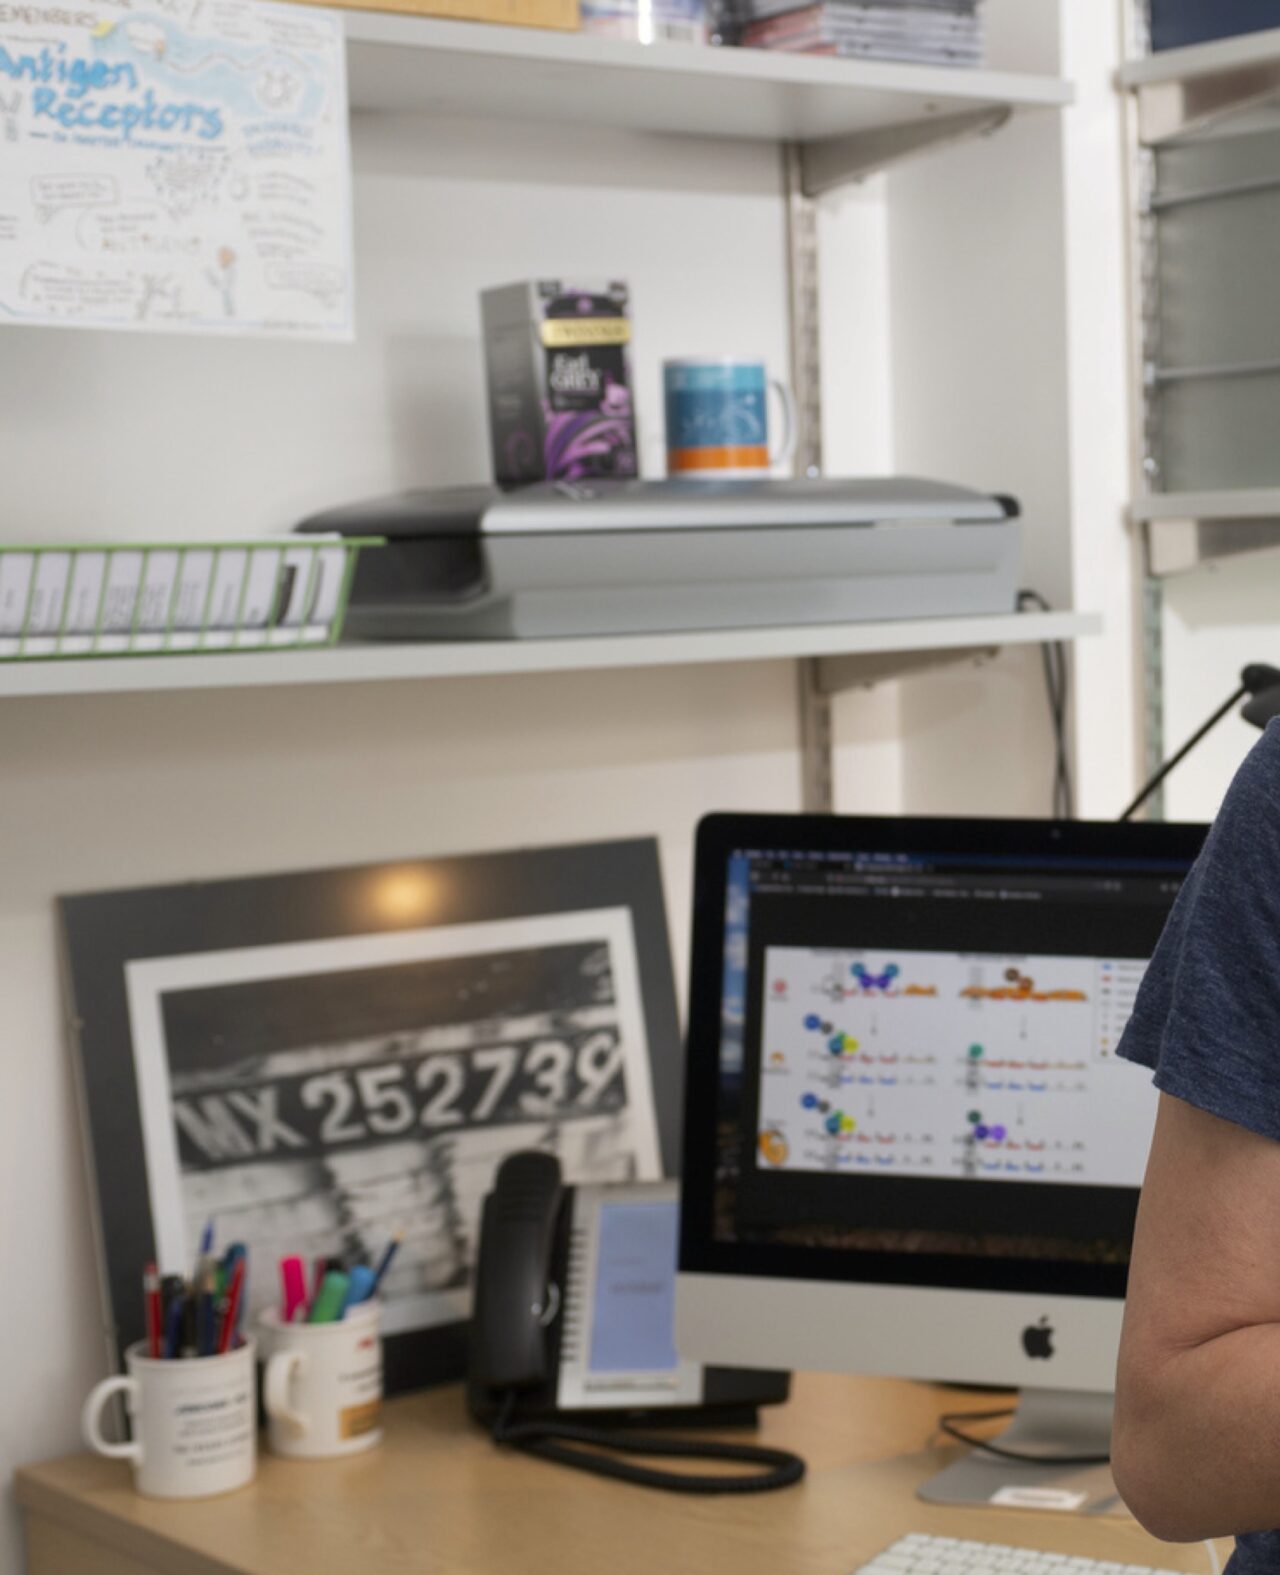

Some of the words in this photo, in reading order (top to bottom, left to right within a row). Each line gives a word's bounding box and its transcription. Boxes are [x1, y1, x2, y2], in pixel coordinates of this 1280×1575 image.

[32, 86, 224, 139] Receptors
[174, 1087, 307, 1160] MX
[306, 1034, 622, 1143] 252739
